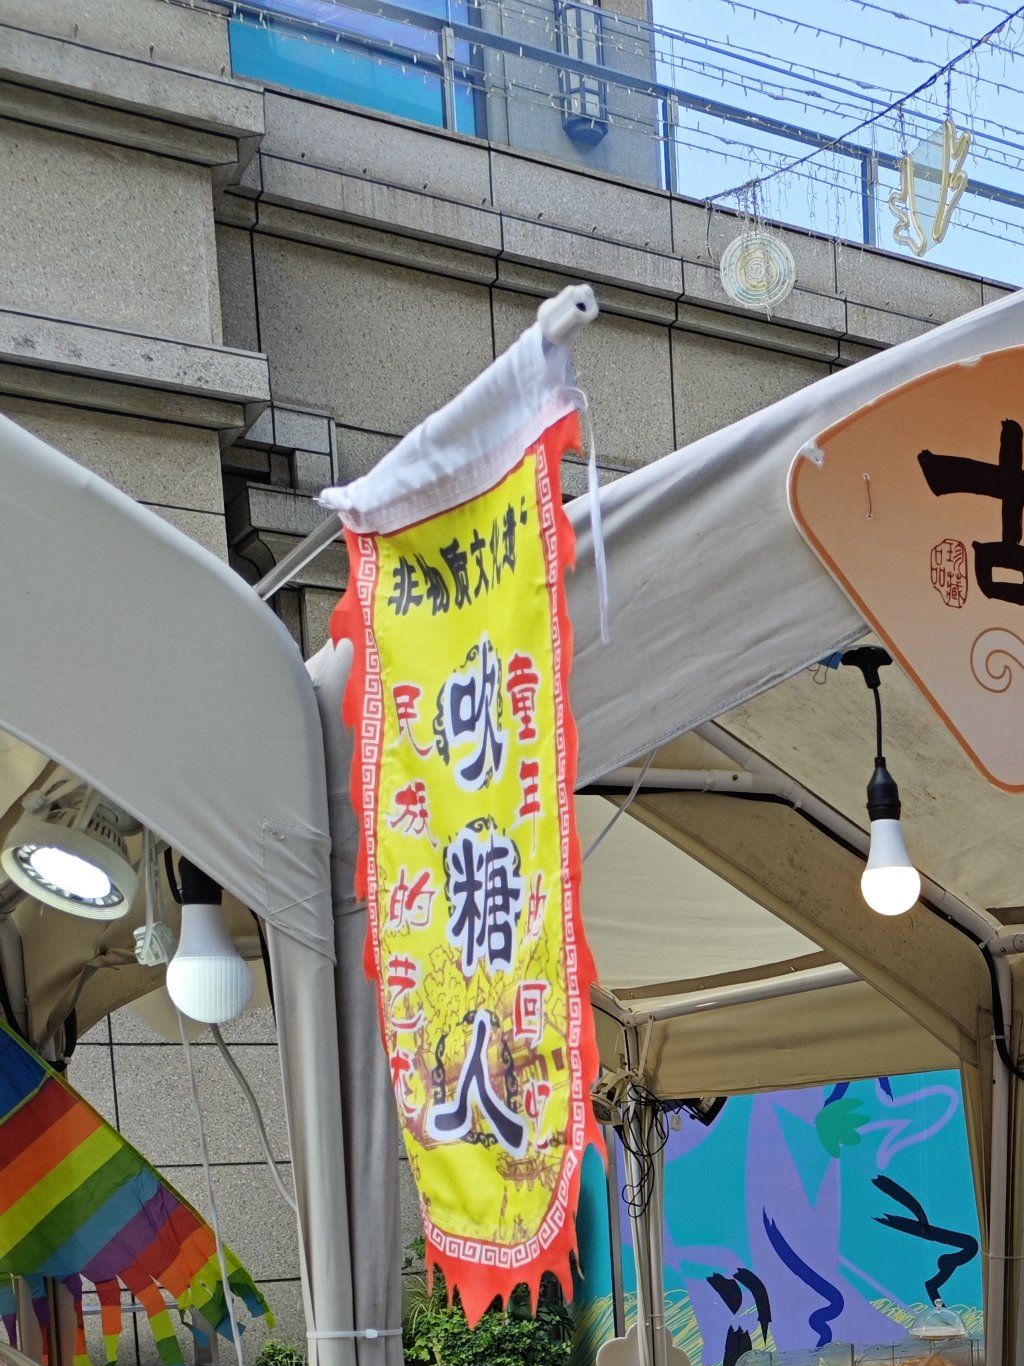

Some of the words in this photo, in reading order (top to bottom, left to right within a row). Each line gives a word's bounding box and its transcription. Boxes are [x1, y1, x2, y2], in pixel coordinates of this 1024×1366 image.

[387, 496, 528, 616] 非物质文化遗
[387, 684, 437, 1119] 民族的艺术
[433, 638, 525, 1150] 吹糖人
